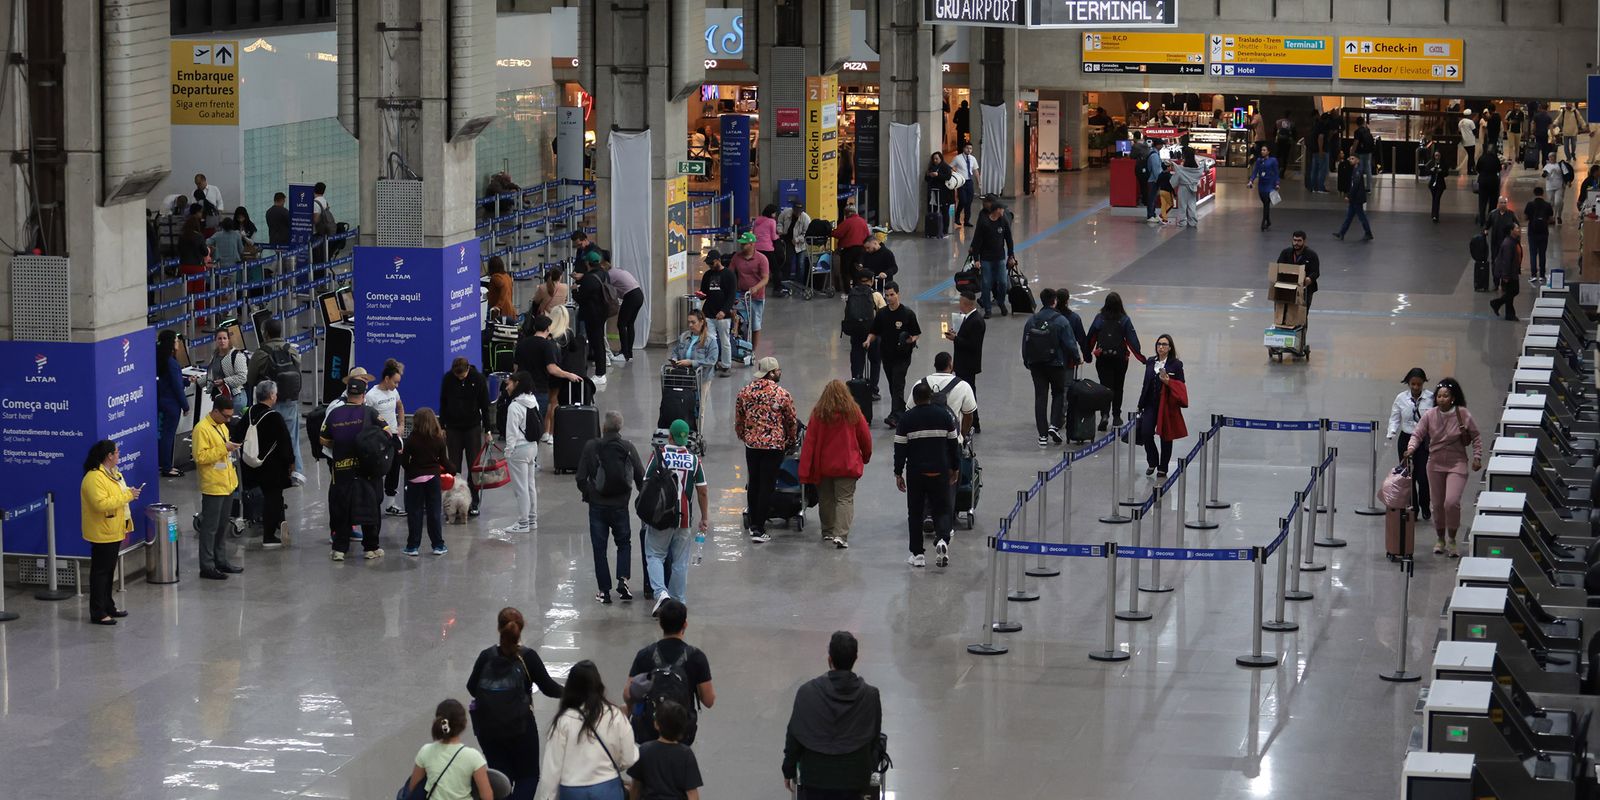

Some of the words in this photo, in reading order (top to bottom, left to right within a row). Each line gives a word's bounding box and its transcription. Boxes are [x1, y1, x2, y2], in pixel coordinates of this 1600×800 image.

[935, 0, 960, 19] GRU
[961, 0, 1017, 22] AIRPORT
[1065, 0, 1152, 21] TERMINAL
[1285, 40, 1318, 49] Terminal
[1319, 40, 1324, 49] 1
[1374, 43, 1418, 53] Check-in
[843, 62, 867, 71] PIZZA
[1237, 66, 1256, 74] Hotel
[1353, 64, 1393, 73] Elevador
[1400, 66, 1430, 75] Elevator
[177, 70, 234, 84] Embarque
[172, 84, 234, 97] Departures
[810, 89, 817, 100] 2
[176, 99, 193, 110] Siga
[209, 99, 234, 108] frente
[198, 110, 210, 118] Go
[211, 110, 235, 118] ahead
[810, 109, 818, 122] E
[808, 131, 819, 180] Check-in
[456, 265, 469, 274] LATAM
[366, 291, 399, 303] Começa
[400, 292, 421, 303] aqui!
[450, 288, 465, 301] Começa
[117, 362, 135, 374] LATAM
[107, 393, 130, 409] Começa
[129, 385, 144, 404] aqui!
[2, 397, 42, 413] Começa
[43, 399, 70, 413] aqui!
[2, 412, 18, 420] Start
[18, 412, 34, 420] here!
[2, 428, 51, 436] Autoatendimento
[59, 429, 84, 437] check-in
[3, 449, 27, 457] Etiquete
[38, 450, 65, 459] Bagagem
[664, 452, 692, 462] AME
[673, 460, 692, 469] RIO
